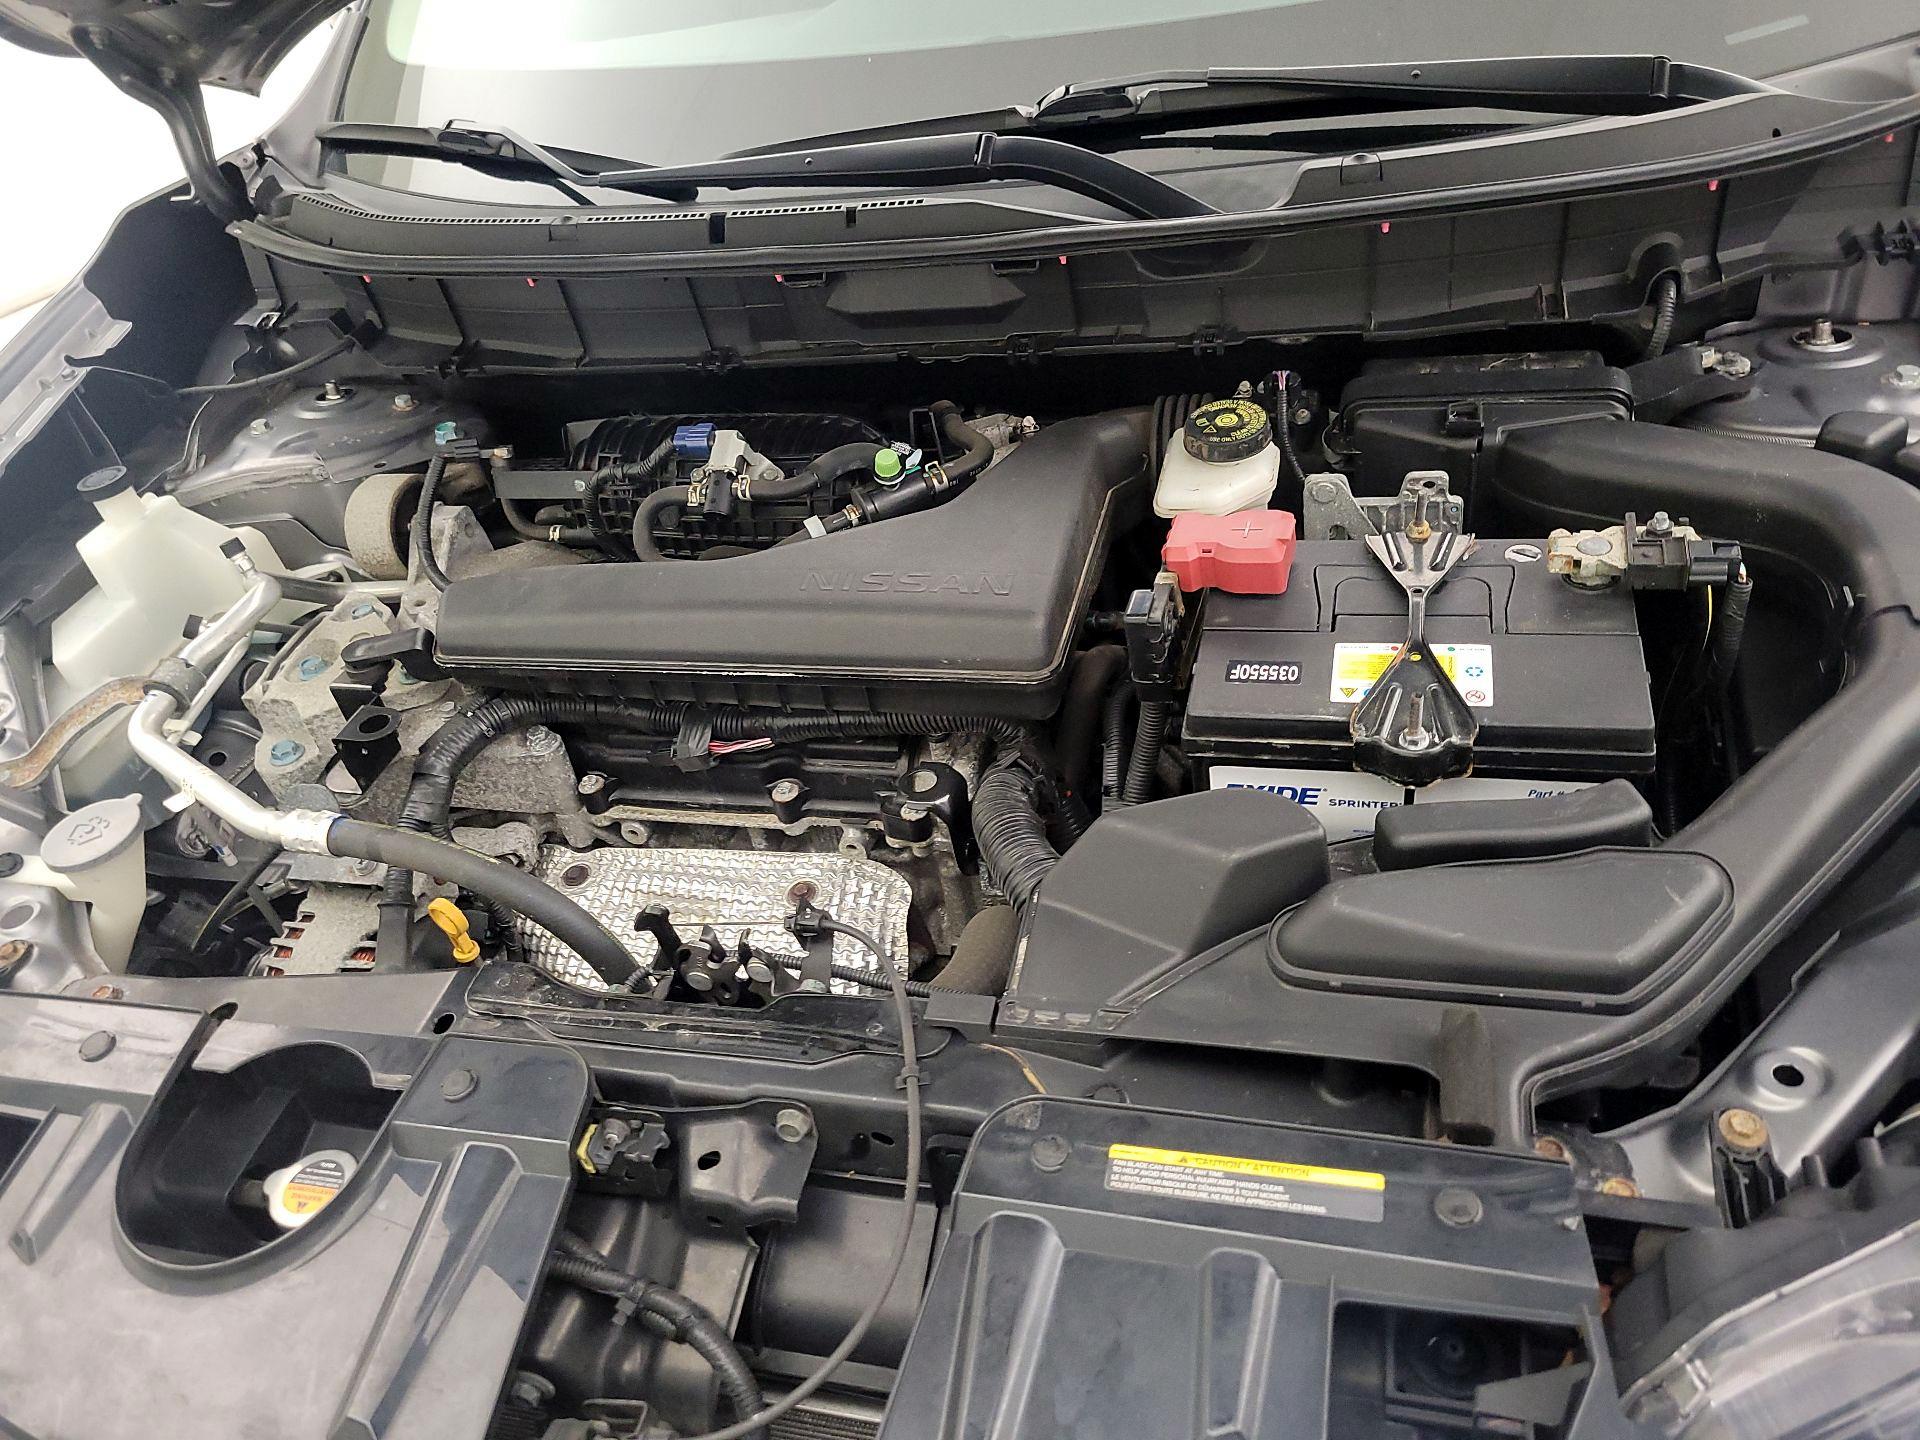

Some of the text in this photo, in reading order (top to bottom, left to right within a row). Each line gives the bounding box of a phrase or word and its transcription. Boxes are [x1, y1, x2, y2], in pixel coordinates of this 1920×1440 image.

[800, 568, 1016, 597] NISSAN
[1229, 664, 1299, 681] 035550F
[1528, 789, 1553, 798] Part
[1127, 1160, 1149, 1169] BLADE
[1149, 1162, 1163, 1170] CAN
[1164, 1164, 1183, 1173] START
[1192, 1167, 1208, 1175] ANY
[1122, 1167, 1140, 1175] HELP
[1140, 1169, 1160, 1178] AVOID
[1160, 1171, 1195, 1181] PERSONAL
[1218, 1177, 1236, 1186] KEEP
[1236, 1180, 1260, 1190] HANDS
[1246, 1198, 1290, 1209] APPROCHER
